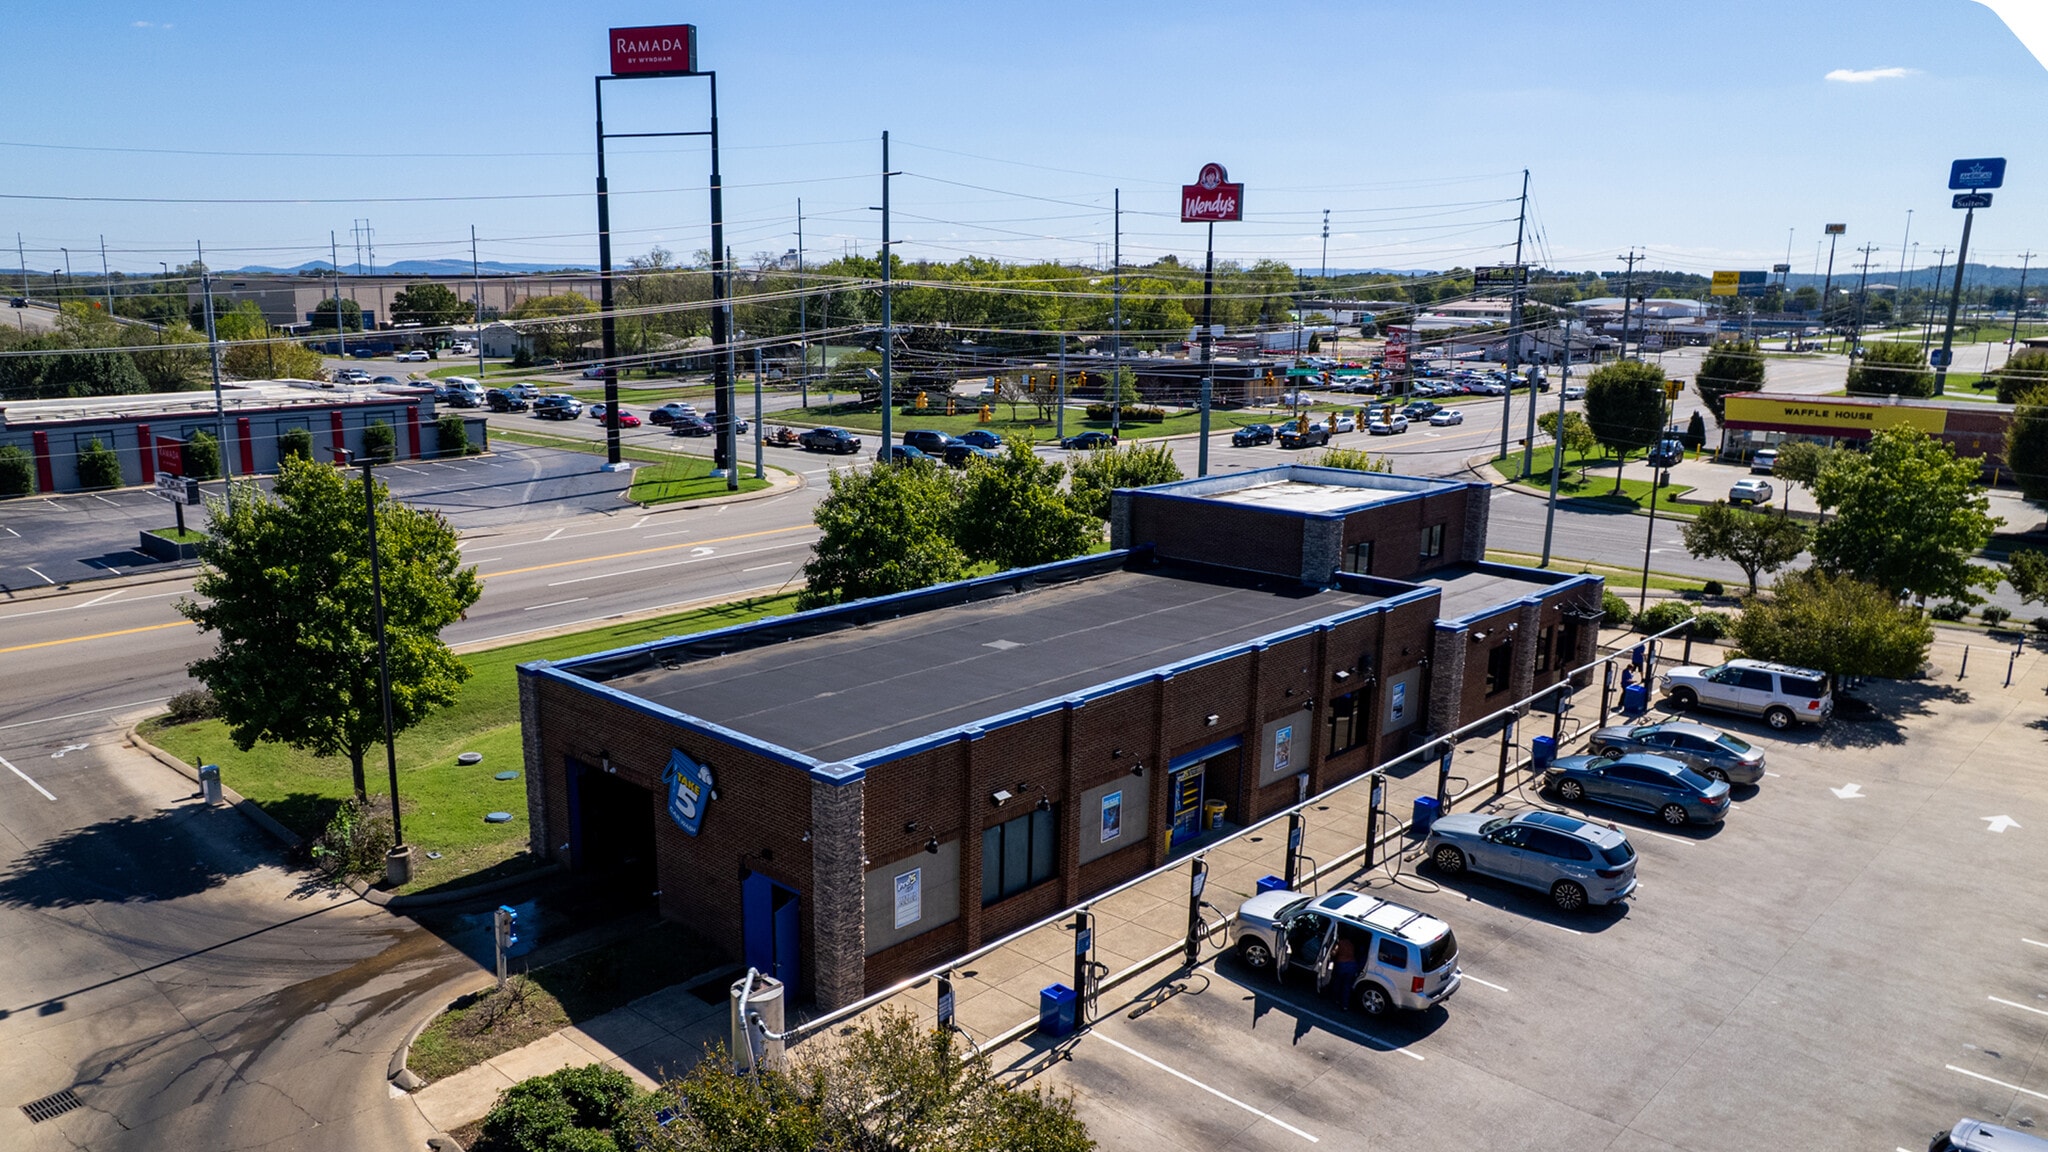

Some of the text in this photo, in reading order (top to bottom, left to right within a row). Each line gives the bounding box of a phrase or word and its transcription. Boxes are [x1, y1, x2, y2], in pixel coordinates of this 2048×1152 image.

[616, 38, 682, 54] RAMADA
[1185, 192, 1235, 218] Wendy's
[1784, 408, 1873, 420] WAFFLE HOUSE
[677, 772, 701, 796] TAKE
[675, 783, 698, 819] 5
[669, 806, 697, 833] CAR WASH
